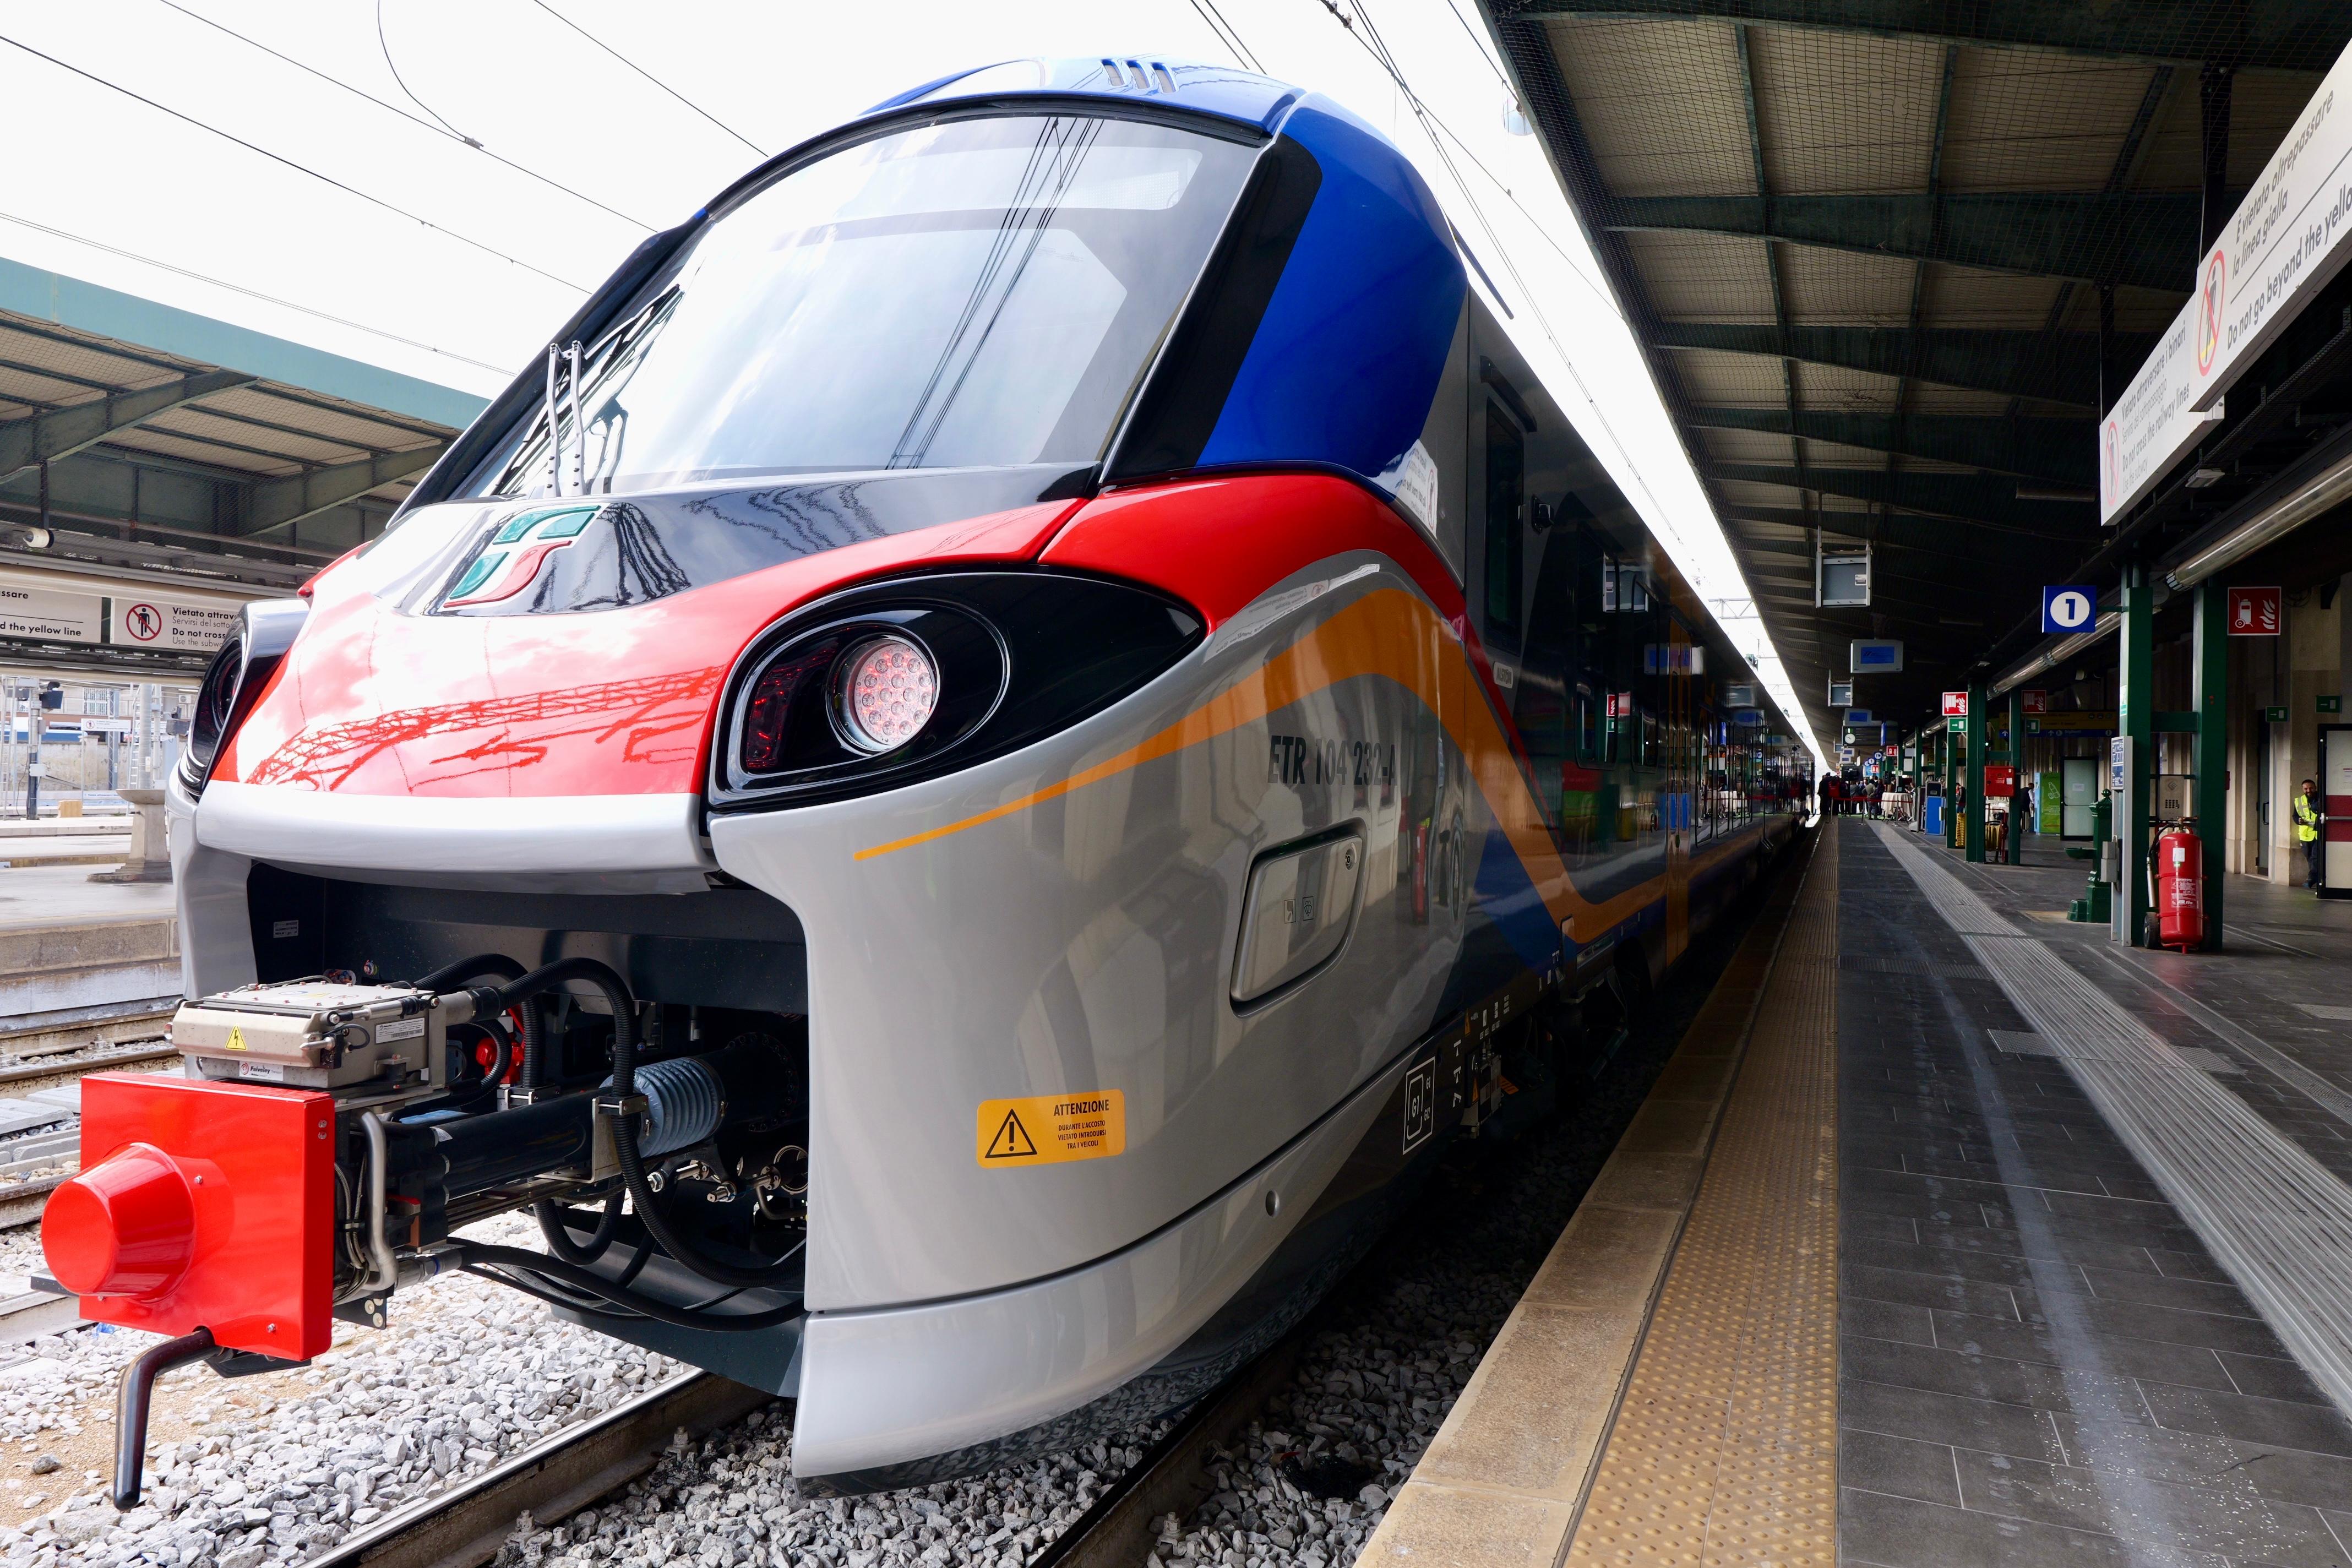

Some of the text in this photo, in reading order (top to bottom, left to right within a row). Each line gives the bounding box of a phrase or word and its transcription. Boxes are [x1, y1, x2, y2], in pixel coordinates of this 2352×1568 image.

[2242, 183, 2269, 235] vietato
[2272, 90, 2333, 192] oltrepassare
[2233, 189, 2288, 280] la linea gialla
[2228, 324, 2237, 351] Do
[2239, 302, 2252, 337] not
[2254, 292, 2264, 326] go
[2267, 236, 2302, 304] beyond
[2305, 224, 2322, 260] the
[2121, 394, 2136, 422] Vietato
[2137, 354, 2165, 402] attraversare
[2169, 319, 2186, 360] binari
[2122, 454, 2128, 473] Do
[2136, 433, 2147, 456] cross
[2155, 399, 2175, 433] railway
[2176, 382, 2190, 410] lines
[0, 590, 29, 599] ssare
[172, 607, 204, 617] Vietato
[2065, 598, 2076, 620] 1
[172, 616, 198, 626] Servirsi
[200, 618, 211, 627] del
[9, 623, 25, 631] the
[29, 625, 61, 635] yellow
[64, 627, 81, 636] line
[172, 628, 184, 636] Do
[172, 636, 186, 645] Use
[188, 638, 198, 646] the
[1267, 735, 1398, 786] ETR 104 232-A
[250, 1065, 271, 1074] Faiveley
[1053, 1099, 1109, 1117] ATTENZIONE
[1412, 1095, 1420, 1118] G1
[1058, 1120, 1106, 1131] DURANTE L'ACCOSTO
[1079, 1130, 1106, 1139] INTRODURSI
[1080, 1140, 1098, 1148] VEICOLI
